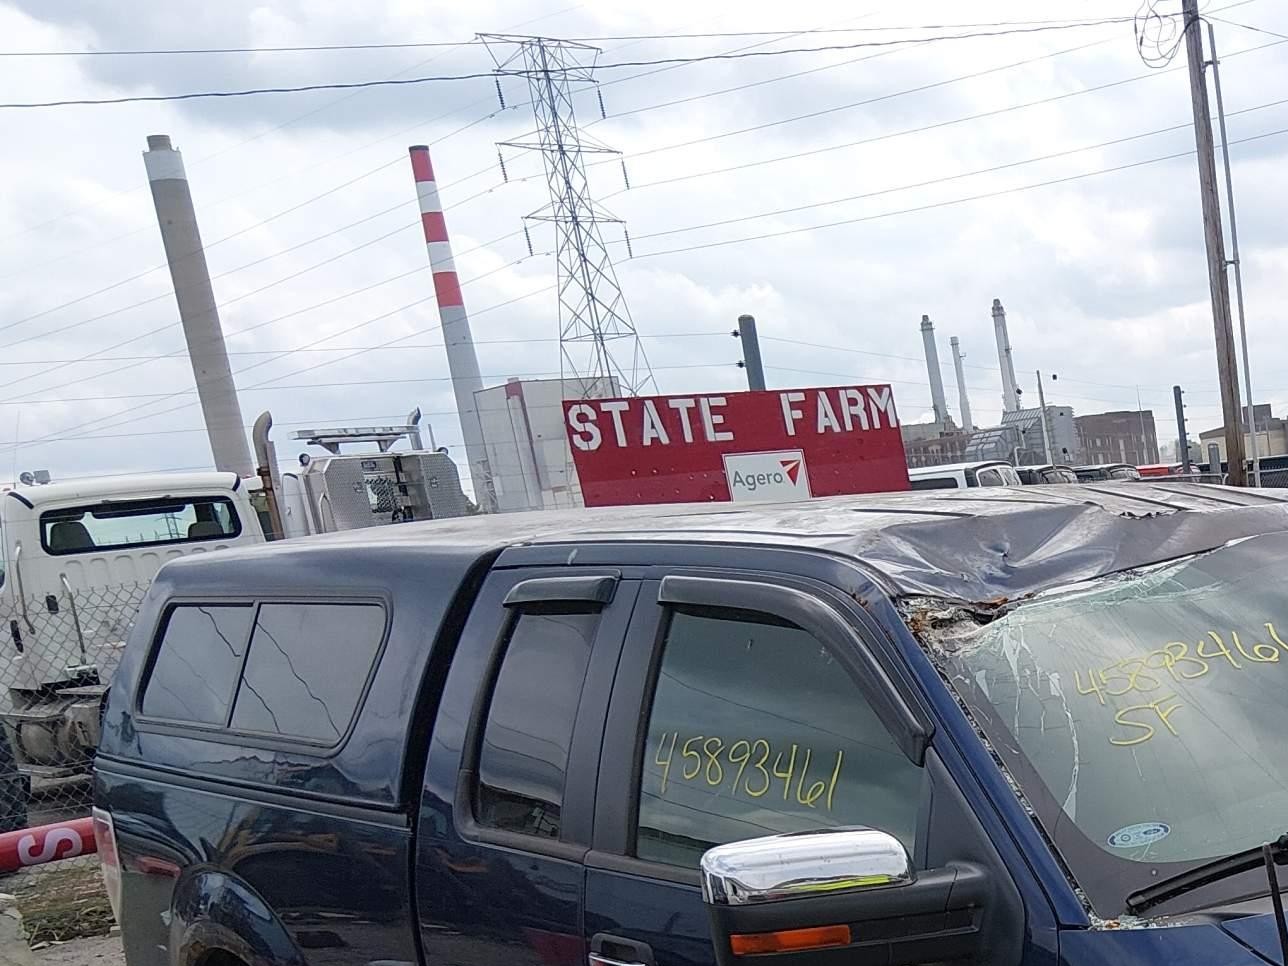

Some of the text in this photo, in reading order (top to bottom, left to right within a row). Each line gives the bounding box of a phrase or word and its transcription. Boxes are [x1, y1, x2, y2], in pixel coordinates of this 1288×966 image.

[568, 386, 897, 451] STATE FARM
[732, 470, 784, 491] Agero
[1109, 693, 1183, 745] SF
[655, 731, 843, 812] 45893461
